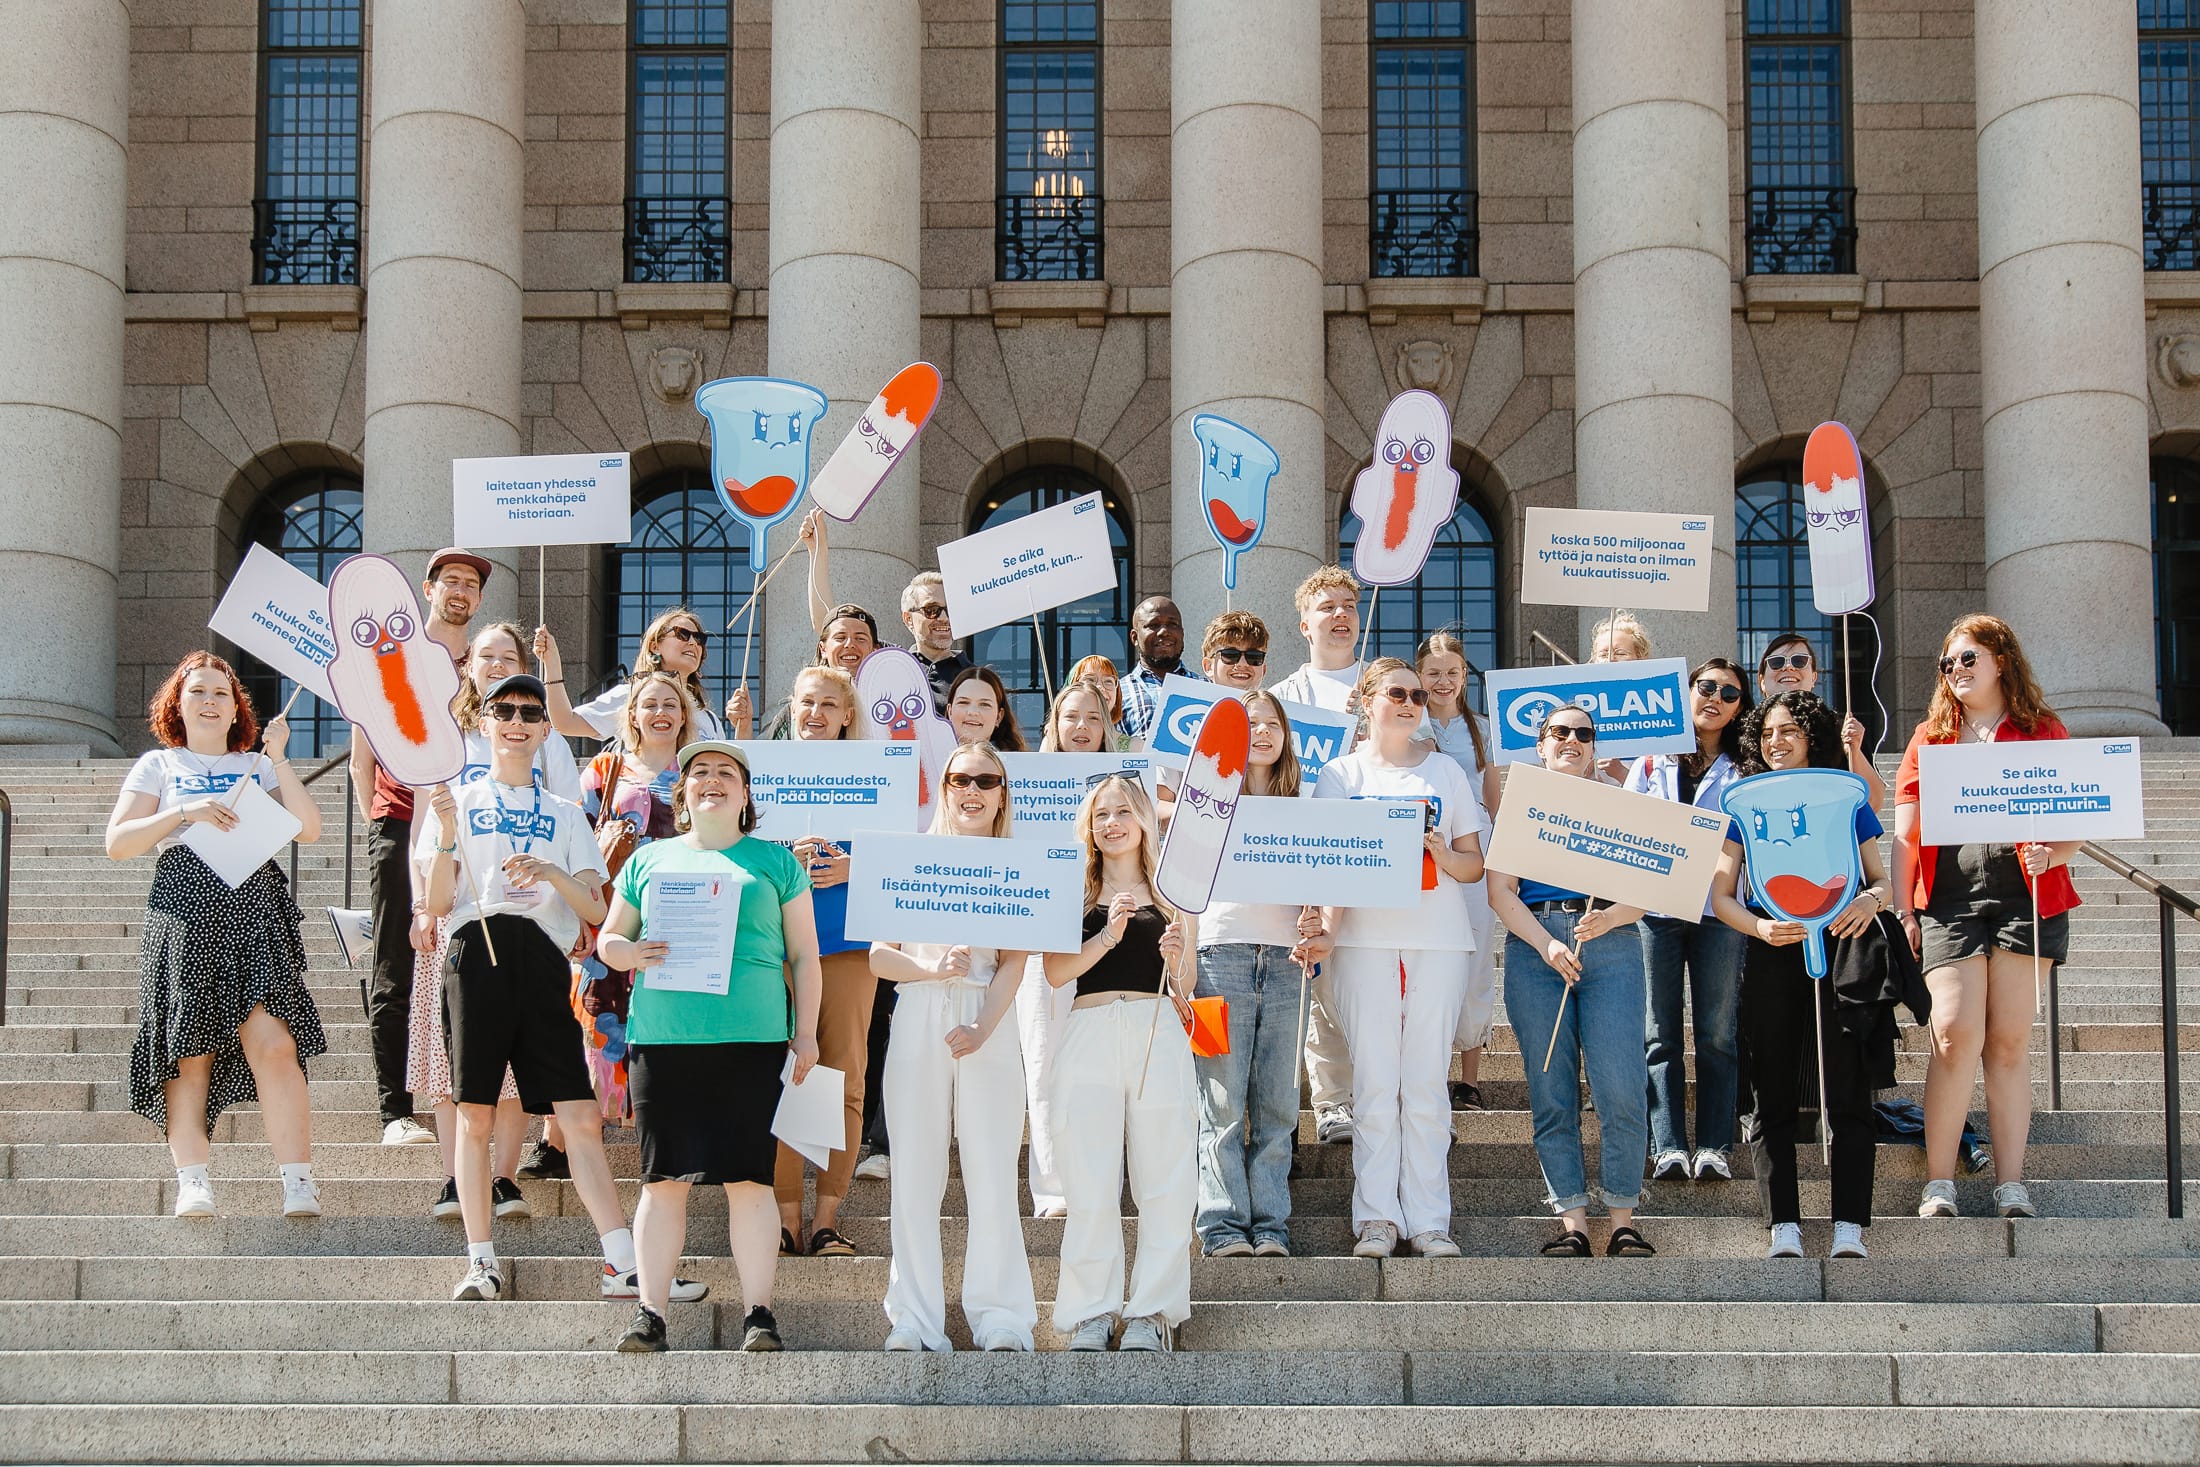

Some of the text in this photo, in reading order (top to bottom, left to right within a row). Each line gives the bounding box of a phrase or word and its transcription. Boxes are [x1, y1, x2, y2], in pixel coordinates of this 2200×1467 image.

[486, 478, 596, 492] laitetaan yhdessä
[496, 492, 586, 506] menkkahäpeä
[508, 508, 574, 519] historiaan.
[1551, 534, 1686, 551] koska 500 miljoonaa
[1002, 546, 1044, 568] Se aika
[1538, 550, 1696, 566] tyttöä ja naista on ilman
[970, 553, 1083, 595] kuukaudesta, kun...
[1562, 566, 1670, 583] kuukautissuojia.
[308, 610, 324, 624] Se
[252, 611, 297, 644] menee
[266, 600, 336, 652] kuukaudes
[1575, 688, 1674, 718] PLAN
[1594, 719, 1676, 732] TERNATIONAL
[1291, 730, 1334, 762] AN
[752, 774, 891, 787] aika kuukaudesta,
[2002, 767, 2057, 779] Se aika
[1008, 778, 1082, 789] seksuaali-
[1961, 782, 2100, 797] kuukaudesta, kun
[777, 790, 807, 804] pää
[810, 790, 874, 804] hajoaa...
[1954, 798, 2110, 816] menee kuppi nurin...
[1703, 820, 1720, 828] PLAN
[1243, 833, 1384, 850] koska kuukautiset
[1527, 807, 1689, 860] Se aika kuukaudesta,
[1538, 828, 1567, 846] kun
[1060, 850, 1077, 858] PLAN
[1233, 850, 1392, 868] eristävät tytöt kotiin.
[914, 863, 1020, 883] seksuaali- ja
[882, 878, 1050, 900] lisääntymisoikeudet
[895, 897, 1035, 917] kuuluvat kaikille.
